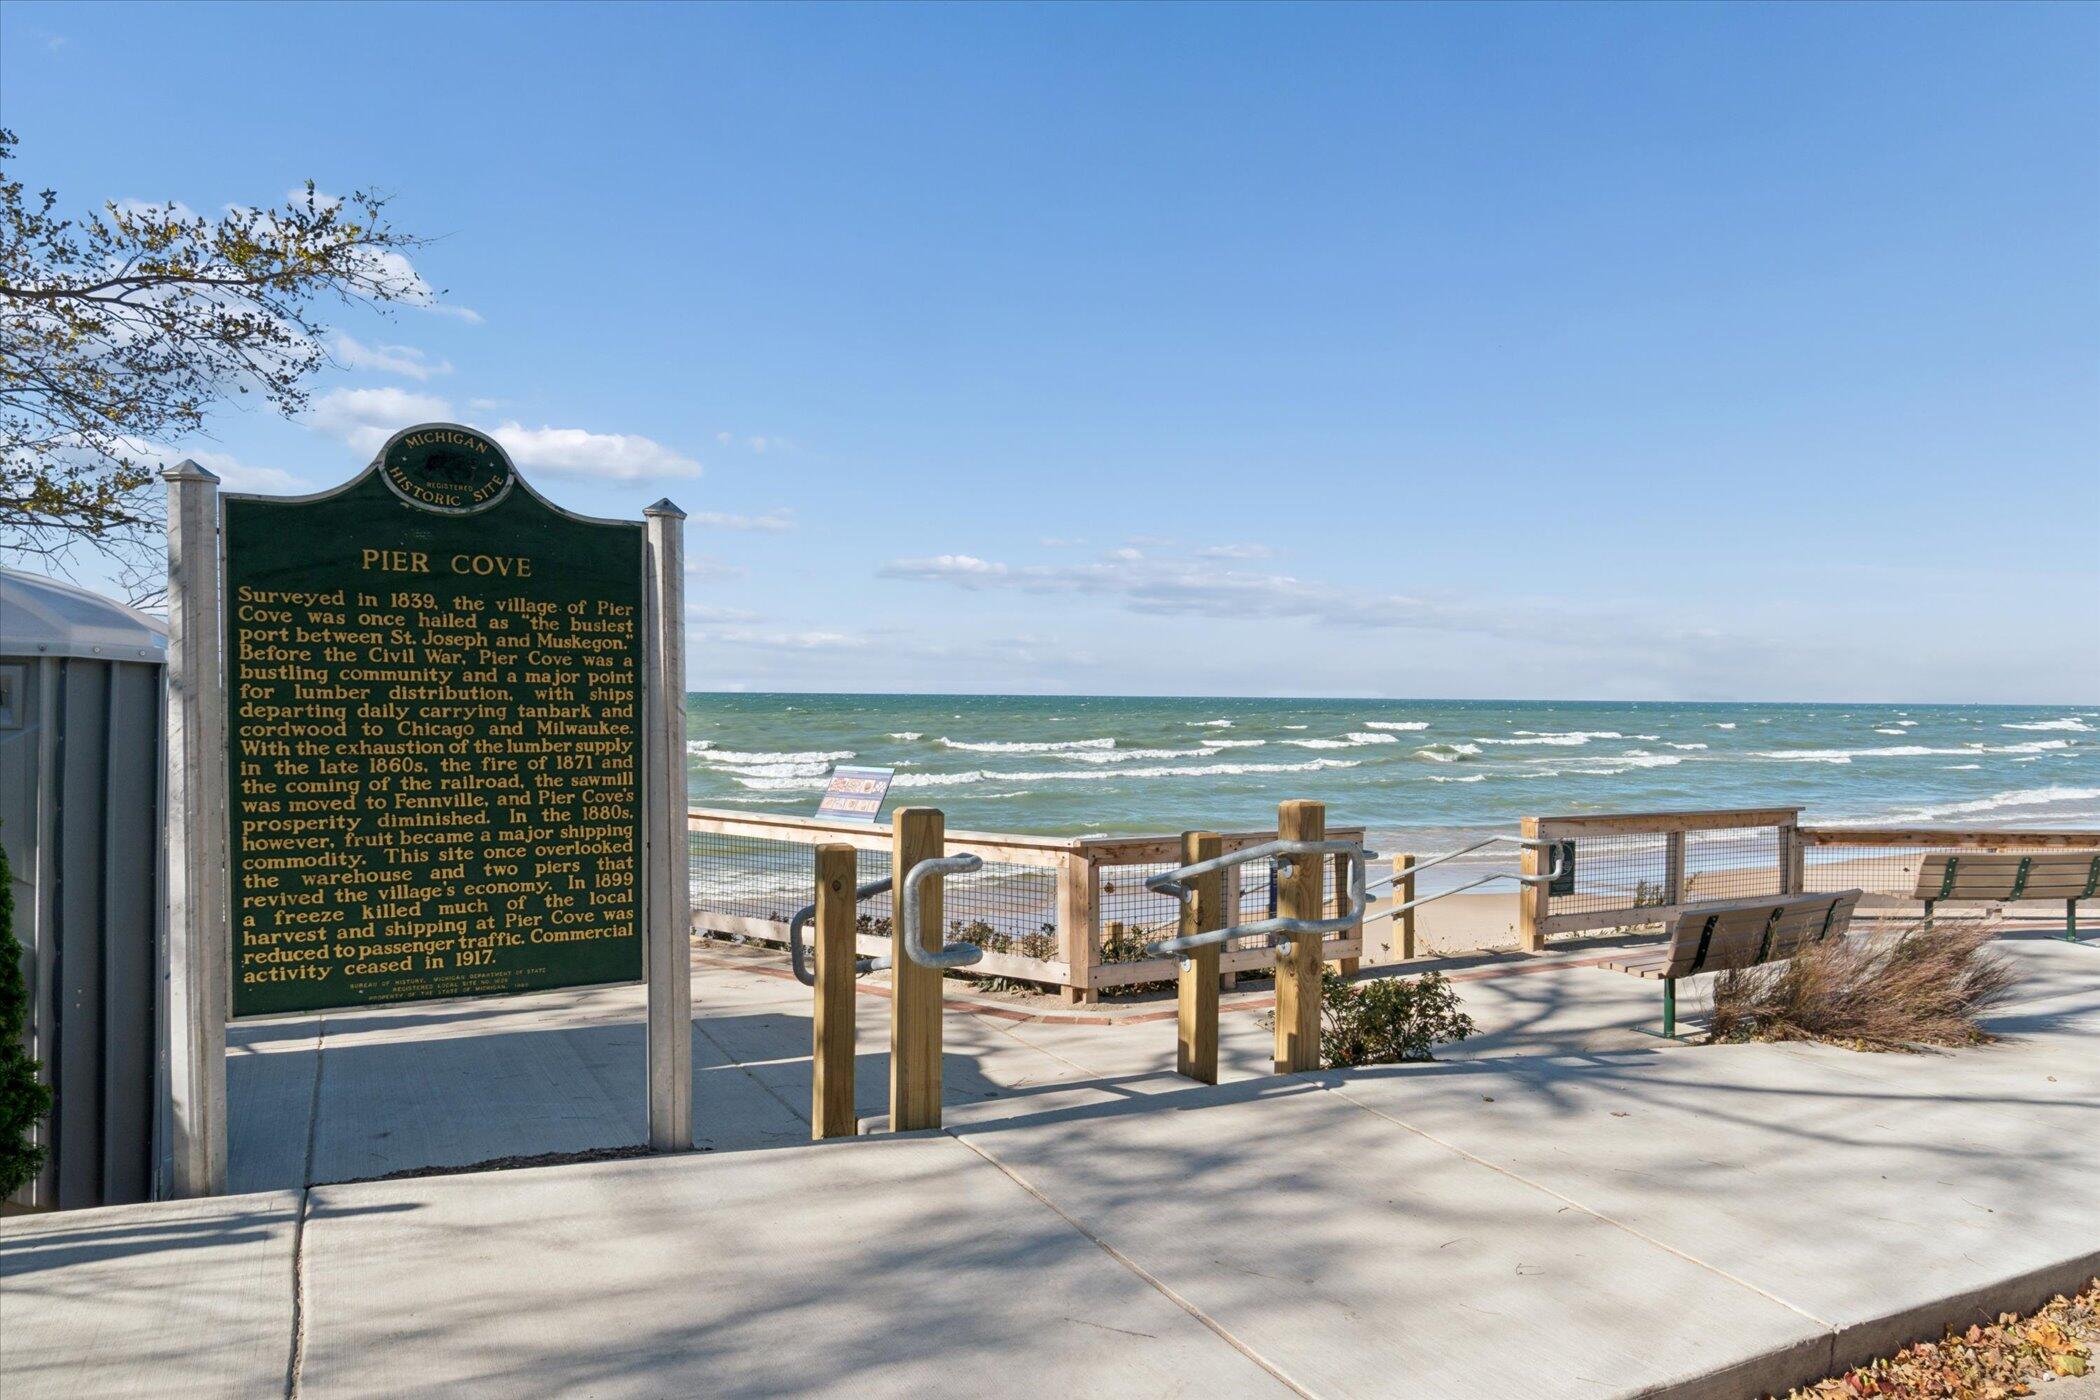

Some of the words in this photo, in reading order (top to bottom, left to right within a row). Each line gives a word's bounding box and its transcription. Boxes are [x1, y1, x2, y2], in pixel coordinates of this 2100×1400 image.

[405, 431, 488, 454] MICHIGAN
[390, 466, 461, 506] HISTORIC
[473, 475, 503, 502] SITE
[426, 481, 473, 492] REGISTERED
[361, 549, 430, 573] PIER
[451, 554, 531, 577] COVE
[238, 585, 345, 607] Surveyed
[358, 592, 378, 607] in
[391, 592, 438, 610] 1839,
[452, 595, 485, 611] the
[496, 597, 557, 617] village
[567, 599, 587, 615] of
[597, 600, 633, 616] Pier
[238, 604, 292, 623] Cove
[307, 612, 345, 625] was
[358, 613, 405, 626] once
[418, 611, 477, 628] hailed
[488, 618, 508, 629] as
[570, 616, 633, 633] busiest
[239, 627, 289, 644] port
[295, 626, 383, 644] between
[390, 629, 417, 645] St.
[421, 629, 488, 651] Joseph
[495, 633, 530, 647] and
[239, 642, 311, 661] Before
[323, 646, 357, 662] the
[368, 646, 415, 663] Civil
[424, 648, 466, 665] War,
[479, 649, 518, 665] Pier
[528, 650, 572, 666] Cove
[582, 655, 613, 667] was
[622, 656, 633, 667] a
[239, 663, 328, 685] bustling
[339, 667, 453, 685] community
[462, 667, 497, 682] and
[506, 671, 517, 683] a
[524, 669, 580, 687] major
[587, 670, 634, 686] point
[239, 683, 275, 699] for
[294, 683, 370, 700] lumber
[388, 684, 513, 701] distribution,
[534, 686, 574, 701] with
[589, 686, 634, 704] ships
[239, 701, 346, 721] departing
[356, 702, 410, 720] daily
[419, 703, 507, 721] carrying
[516, 703, 592, 718] tanbark
[601, 703, 633, 718] and
[239, 719, 347, 737] cordwood
[361, 722, 383, 736] to
[397, 720, 474, 739] Chicago
[488, 720, 523, 735] and
[536, 719, 634, 735] Milwaukee.
[240, 739, 291, 756] With
[294, 740, 330, 756] the
[335, 739, 444, 755] exhaustion
[448, 738, 469, 754] of
[473, 738, 503, 754] the
[506, 737, 572, 753] lumber
[575, 737, 633, 756] supply
[240, 760, 261, 776] in
[273, 759, 309, 775] the
[319, 758, 358, 774] late
[369, 756, 428, 773] 1860s,
[439, 757, 471, 772] the
[480, 756, 518, 771] fire
[527, 755, 548, 770] of
[556, 754, 593, 770] 1871
[601, 754, 633, 769] and
[240, 778, 277, 794] the
[284, 778, 359, 794] coming
[368, 776, 391, 791] of
[399, 775, 432, 791] the
[440, 773, 524, 790] railroad,
[534, 773, 564, 788] the
[571, 771, 634, 787] sawmill
[241, 801, 281, 813] was
[288, 792, 357, 812] moved
[364, 795, 387, 810] to
[394, 792, 489, 809] Fennville,
[496, 790, 531, 806] and
[538, 789, 576, 805] Pier
[582, 787, 634, 803] Cove's
[241, 814, 362, 836] prosperity
[377, 809, 490, 827] diminished.
[509, 808, 527, 824] In
[540, 807, 571, 822] the
[582, 804, 633, 820] 1880s,
[241, 835, 335, 851] however,
[343, 831, 393, 847] fruit
[399, 829, 474, 845] became
[480, 830, 491, 842] a
[498, 825, 554, 843] major
[560, 823, 633, 841] shipping
[242, 851, 366, 870] commodity.
[383, 847, 429, 864] This
[438, 846, 474, 861] site
[483, 846, 527, 859] once
[534, 837, 633, 857] overlooked
[242, 873, 279, 889] the
[301, 868, 413, 886] warehouse
[429, 863, 465, 880] and
[483, 863, 518, 877] two
[534, 860, 580, 878] piers
[596, 855, 634, 871] that
[243, 888, 324, 908] revived
[334, 887, 368, 903] the
[377, 880, 456, 902] village's
[463, 881, 552, 896] economy.
[568, 874, 586, 890] In
[595, 871, 634, 888] 1899
[242, 915, 256, 927] a
[273, 909, 344, 926] freeze
[361, 901, 422, 920] killed
[438, 898, 488, 915] much
[506, 894, 527, 910] of
[543, 893, 574, 908] the
[589, 888, 633, 905] local
[243, 926, 327, 946] harvest
[336, 921, 375, 940] and
[384, 919, 467, 938] shipping
[475, 915, 495, 930] at
[505, 912, 543, 928] Pier
[550, 909, 595, 925] Cove
[602, 909, 634, 921] was
[243, 943, 329, 965] reduced
[332, 943, 356, 958] to
[358, 939, 455, 961] passenger
[457, 931, 525, 949] traffic.
[530, 923, 633, 944] Commercial
[243, 964, 333, 983] activity
[343, 955, 412, 976] ceased
[424, 955, 444, 970] in
[455, 948, 496, 967] 1917.
